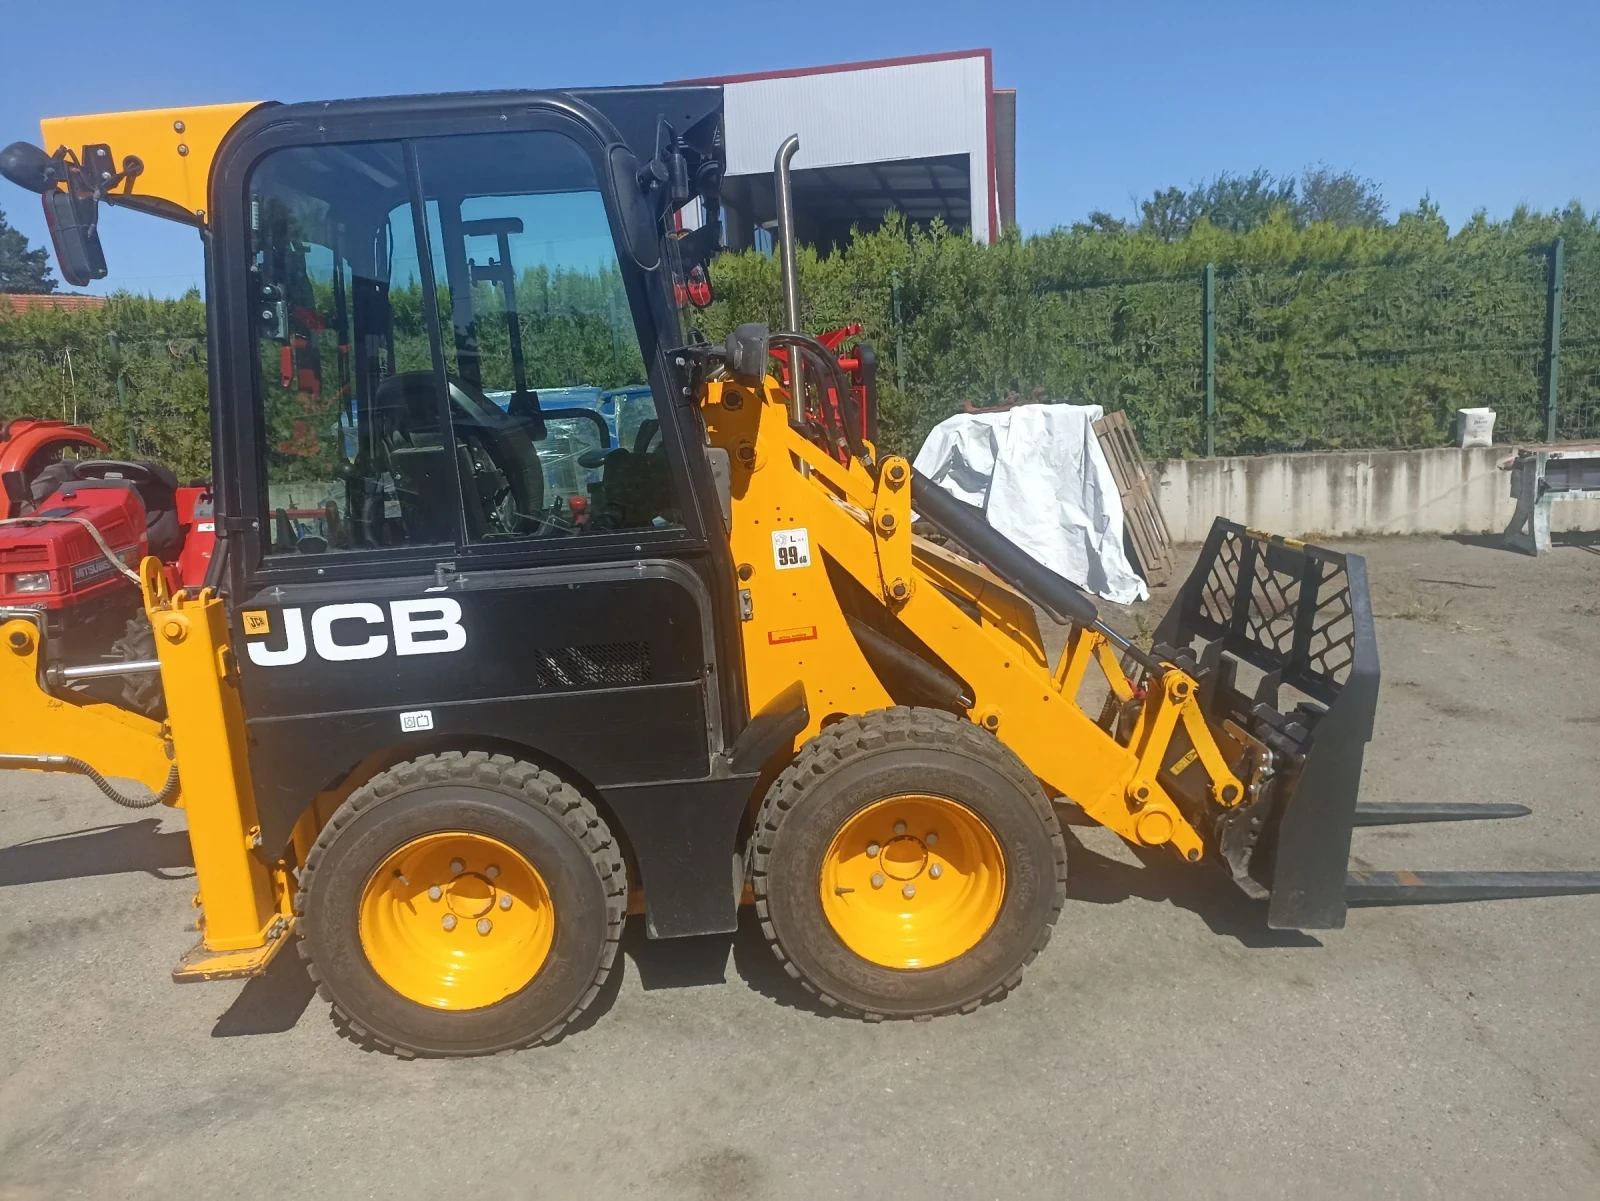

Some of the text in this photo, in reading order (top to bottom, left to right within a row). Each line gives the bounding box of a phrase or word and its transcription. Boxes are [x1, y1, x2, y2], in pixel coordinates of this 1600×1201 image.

[778, 546, 798, 565] 99
[247, 597, 467, 666] JCB
[250, 617, 265, 628] JCB
